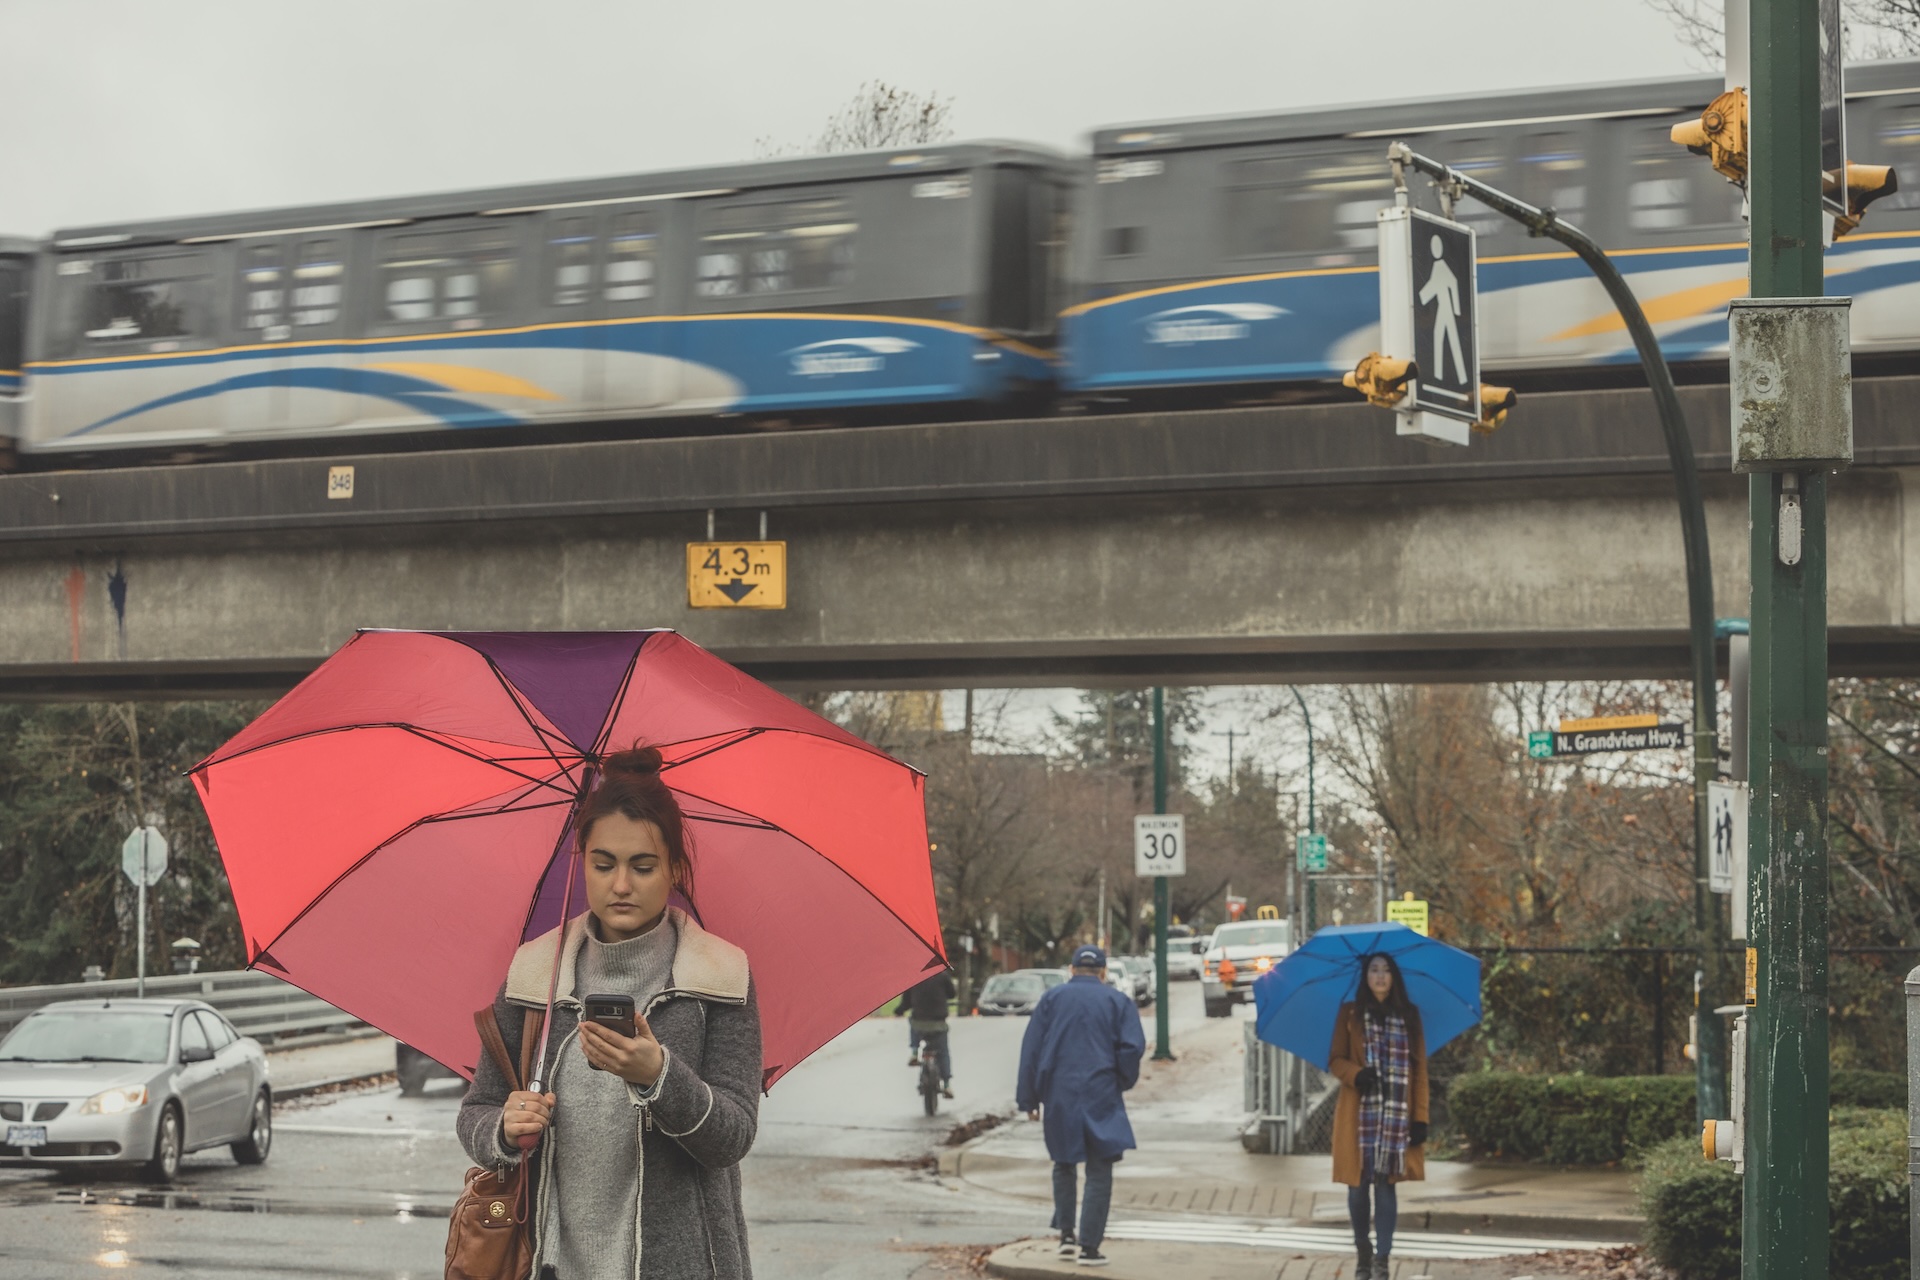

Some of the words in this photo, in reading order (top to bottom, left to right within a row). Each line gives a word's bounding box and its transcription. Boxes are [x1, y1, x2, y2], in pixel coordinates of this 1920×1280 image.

[332, 474, 351, 490] 348
[1557, 735, 1573, 752] N.
[1574, 730, 1647, 751] Grandview
[1648, 728, 1682, 748] Hwy.
[1144, 833, 1177, 860] 30
